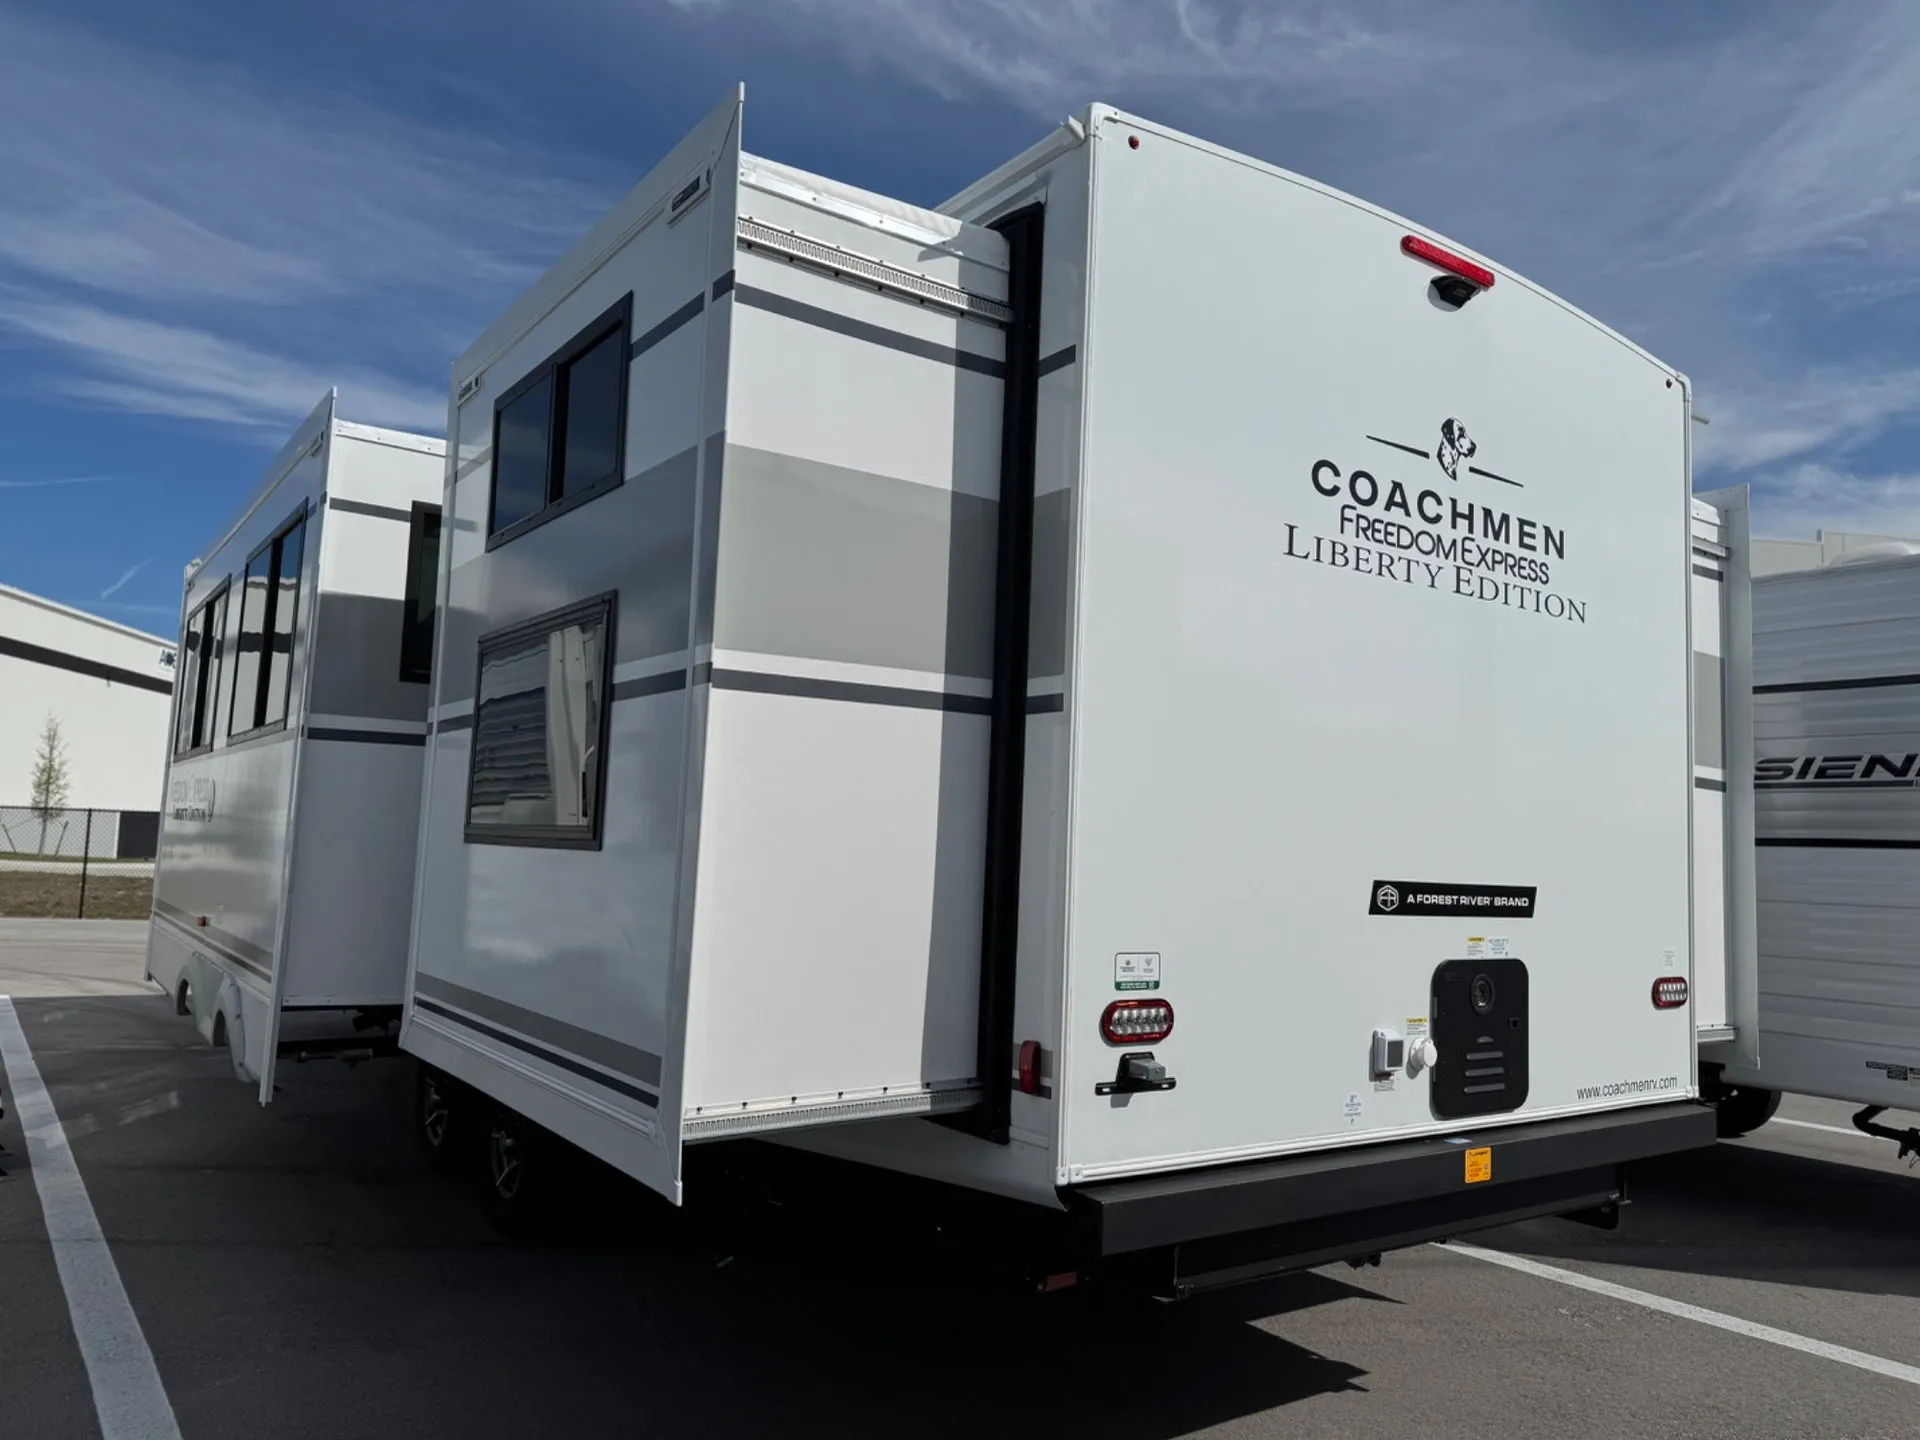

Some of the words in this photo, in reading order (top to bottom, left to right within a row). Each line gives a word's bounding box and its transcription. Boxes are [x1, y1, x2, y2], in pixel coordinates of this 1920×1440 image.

[1311, 459, 1565, 560] COACHMEN
[1283, 522, 1444, 589] LIBERTY
[1452, 564, 1587, 624] EDITION
[1754, 753, 1920, 781] SIEN
[1407, 894, 1416, 904] A
[1416, 894, 1459, 905] FOREST
[1459, 895, 1491, 906] RIVER
[1494, 896, 1529, 907] BRAND
[1576, 1076, 1678, 1100] www.coachmenrv.com
